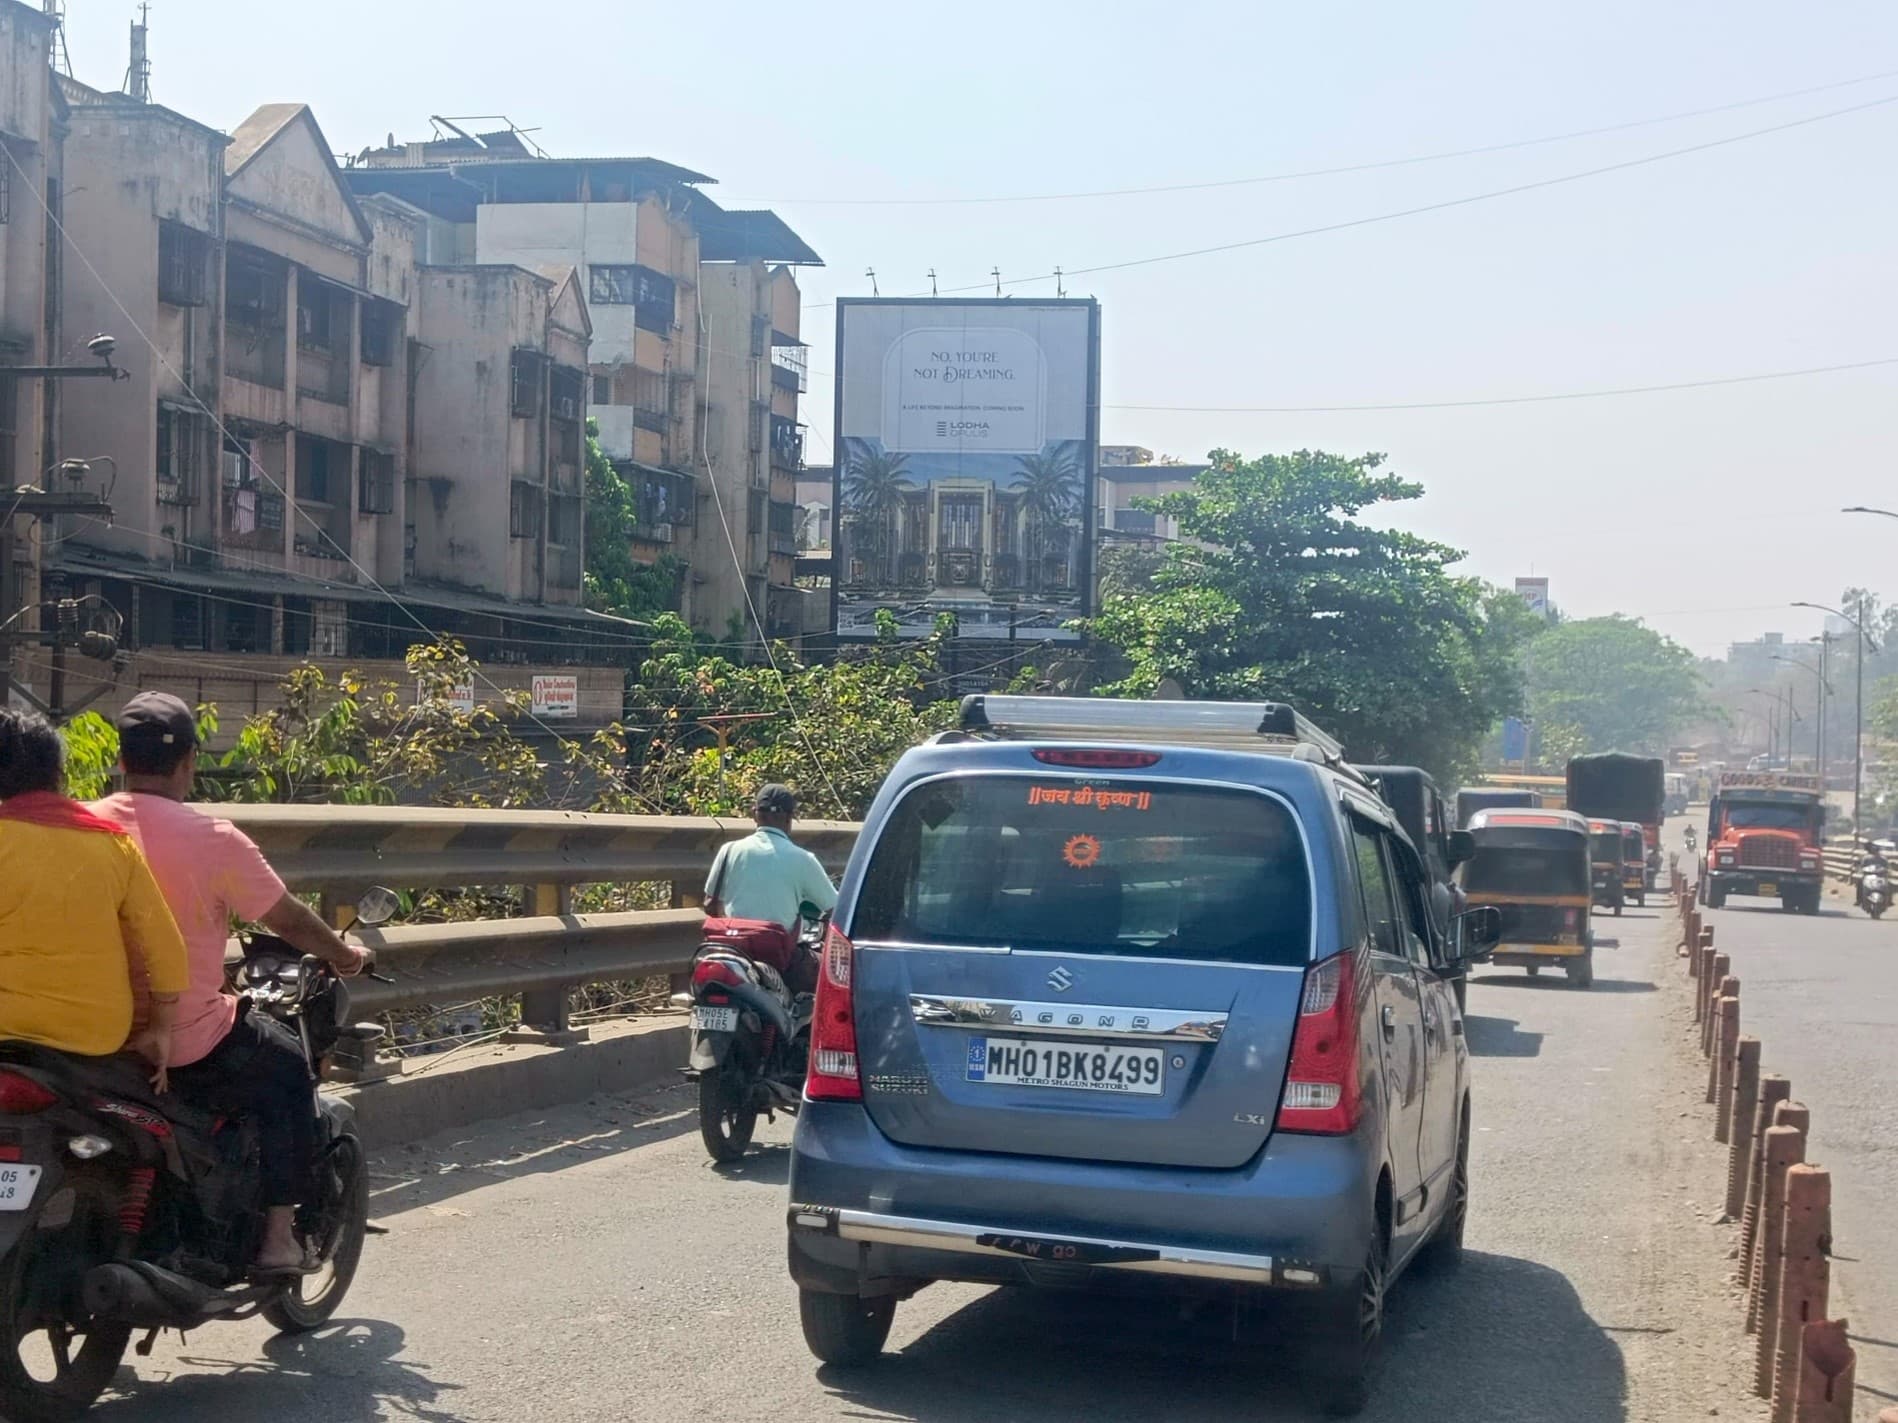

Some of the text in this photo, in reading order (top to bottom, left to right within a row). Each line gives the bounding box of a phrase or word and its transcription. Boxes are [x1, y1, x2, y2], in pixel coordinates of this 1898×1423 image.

[914, 368, 938, 379] NOT
[987, 1046, 1159, 1085] MH01BK8499
[1017, 1076, 1129, 1090] METRO SHAGUN MOTORS
[1, 1170, 18, 1183] 05
